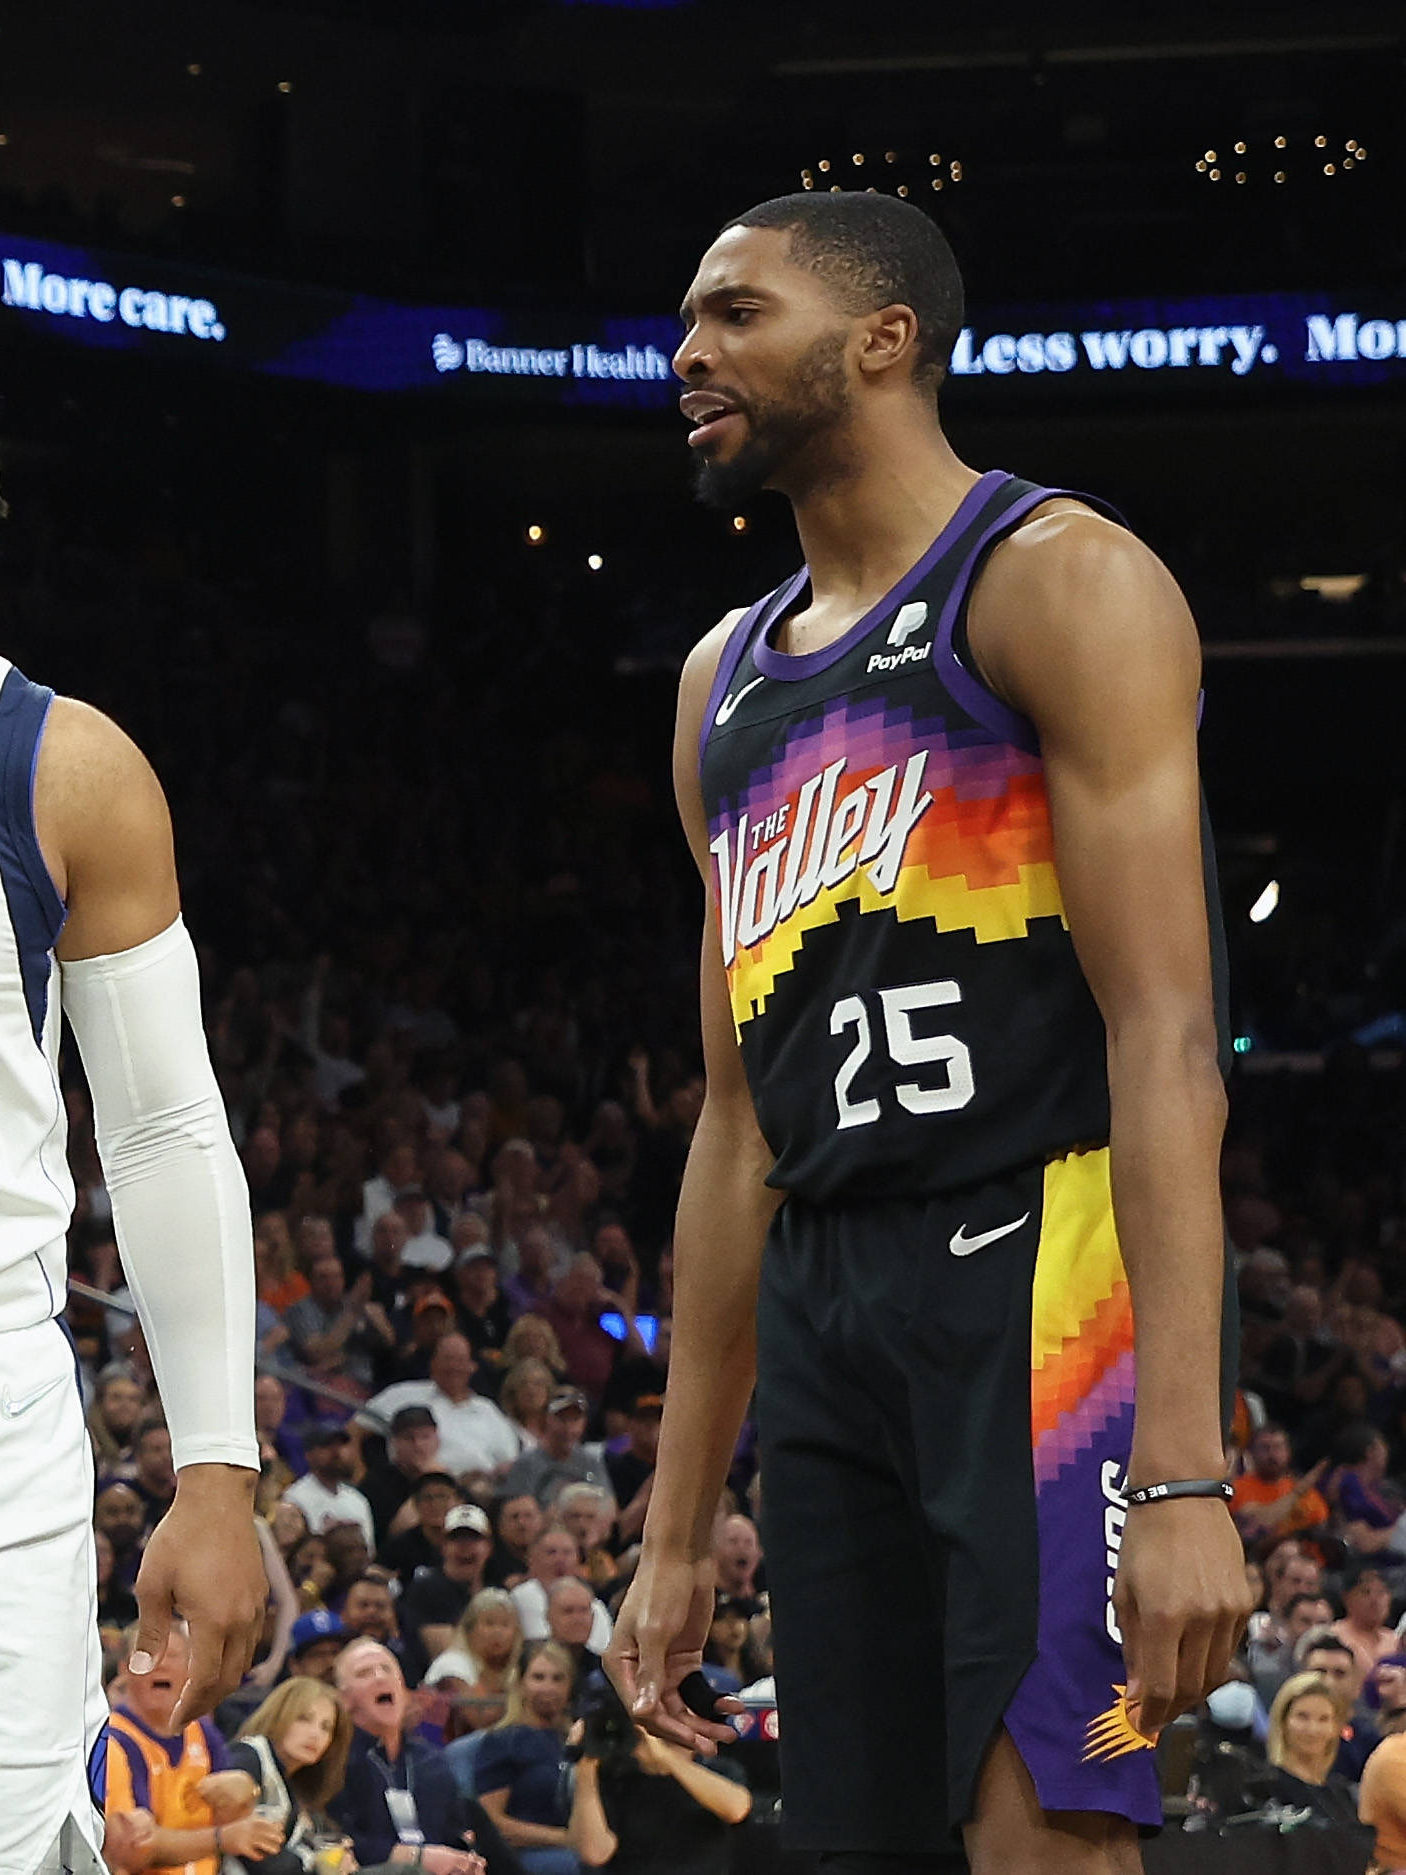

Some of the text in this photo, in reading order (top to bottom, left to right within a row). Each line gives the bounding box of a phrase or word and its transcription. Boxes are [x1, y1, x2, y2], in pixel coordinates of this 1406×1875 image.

[2, 257, 116, 322] More
[119, 287, 228, 342] care.
[466, 338, 670, 380] Banner Health
[949, 325, 1078, 375] Less
[1080, 325, 1280, 376] worry.
[866, 641, 933, 673] PayPal
[751, 804, 790, 850] THE
[709, 749, 935, 968] Valley
[830, 980, 976, 1130] 25
